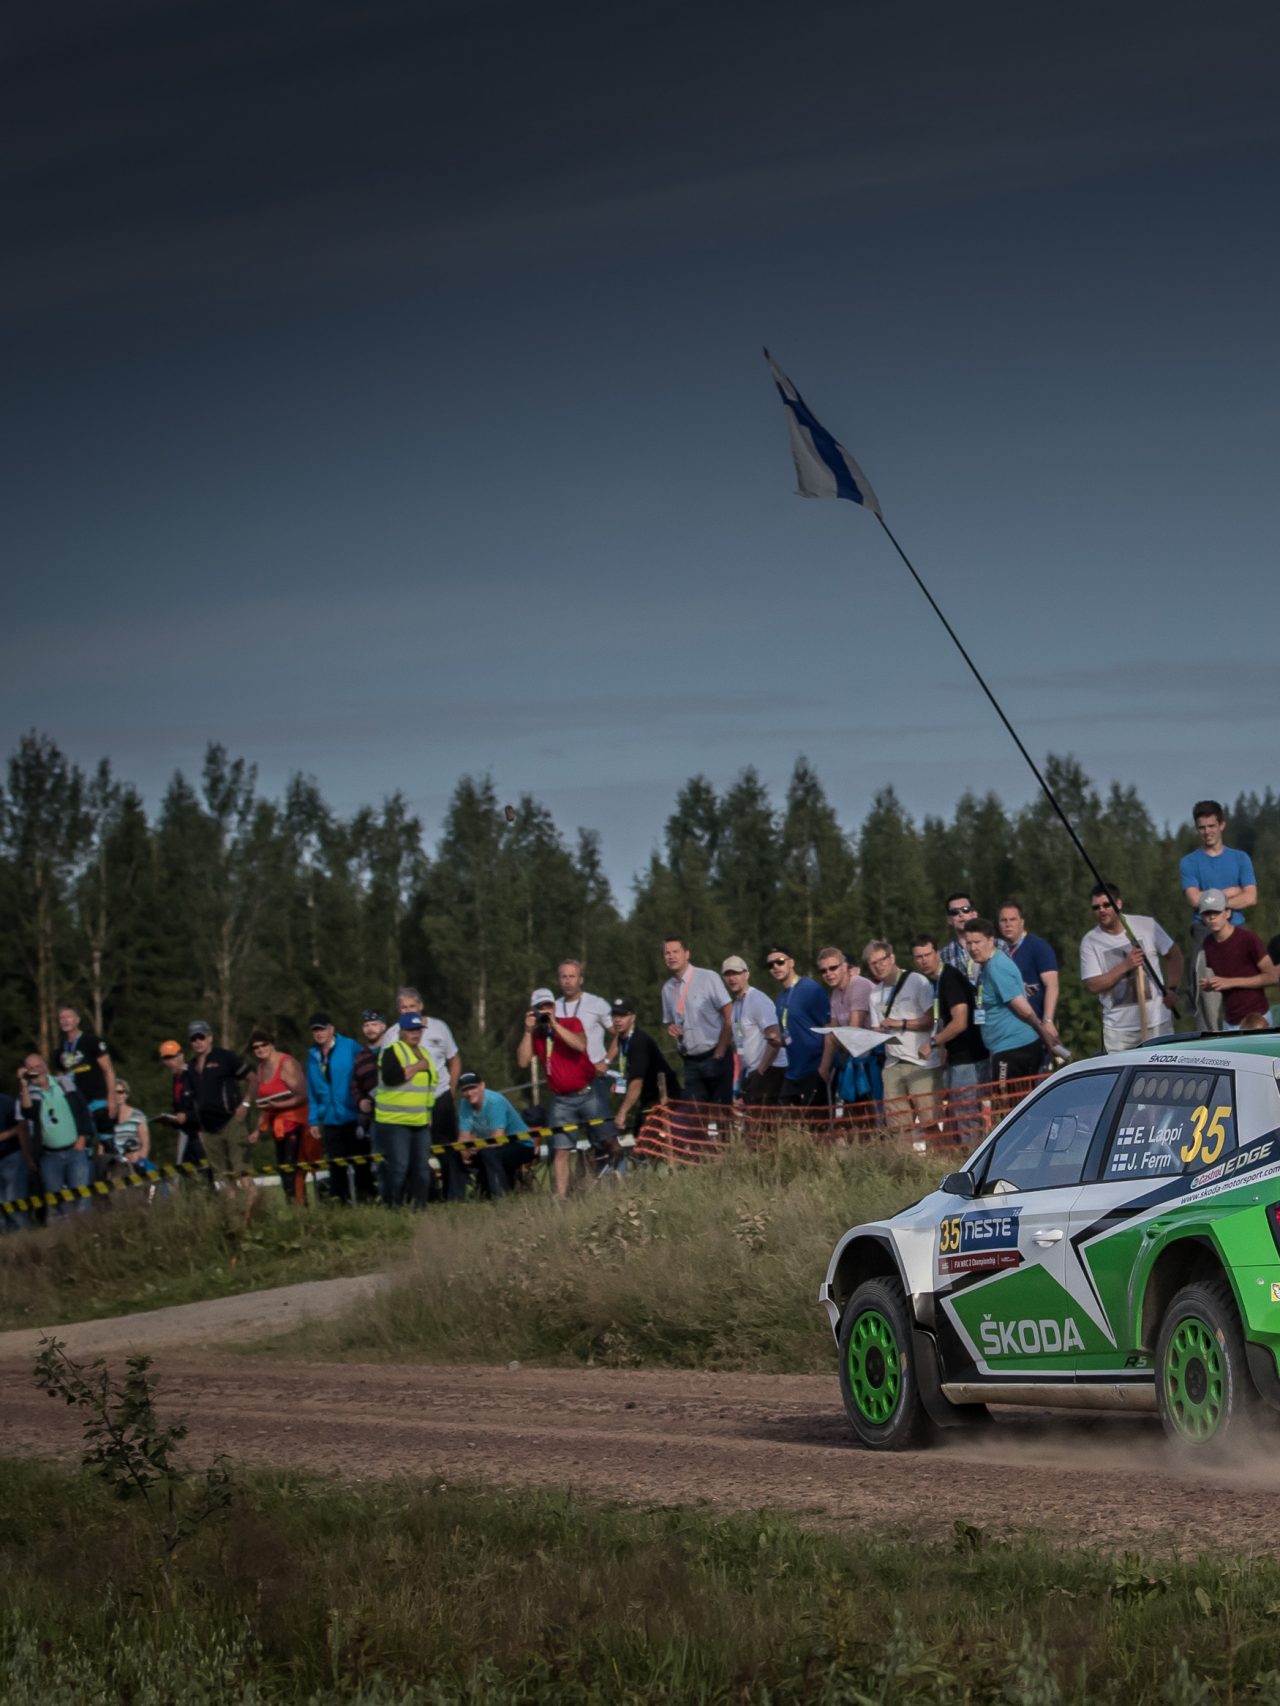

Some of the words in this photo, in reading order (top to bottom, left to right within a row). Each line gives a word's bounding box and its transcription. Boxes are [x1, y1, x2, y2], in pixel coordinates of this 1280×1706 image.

[1148, 1054, 1179, 1063] ŠKODA
[1200, 1057, 1231, 1066] Accessories
[1133, 1127, 1145, 1144] E.
[1148, 1123, 1184, 1146] Lappi
[1180, 1105, 1232, 1164] 35
[1127, 1153, 1137, 1171] J.
[1140, 1152, 1172, 1169] Ferm
[1198, 1166, 1223, 1185] Castrol
[1224, 1140, 1275, 1176] EDGE
[1181, 1165, 1280, 1204] www.skoda-motorsport.com
[940, 1217, 960, 1252] 35
[964, 1217, 1012, 1240] NESTE
[980, 1314, 1086, 1355] ŠKODA
[1124, 1356, 1148, 1368] R5
